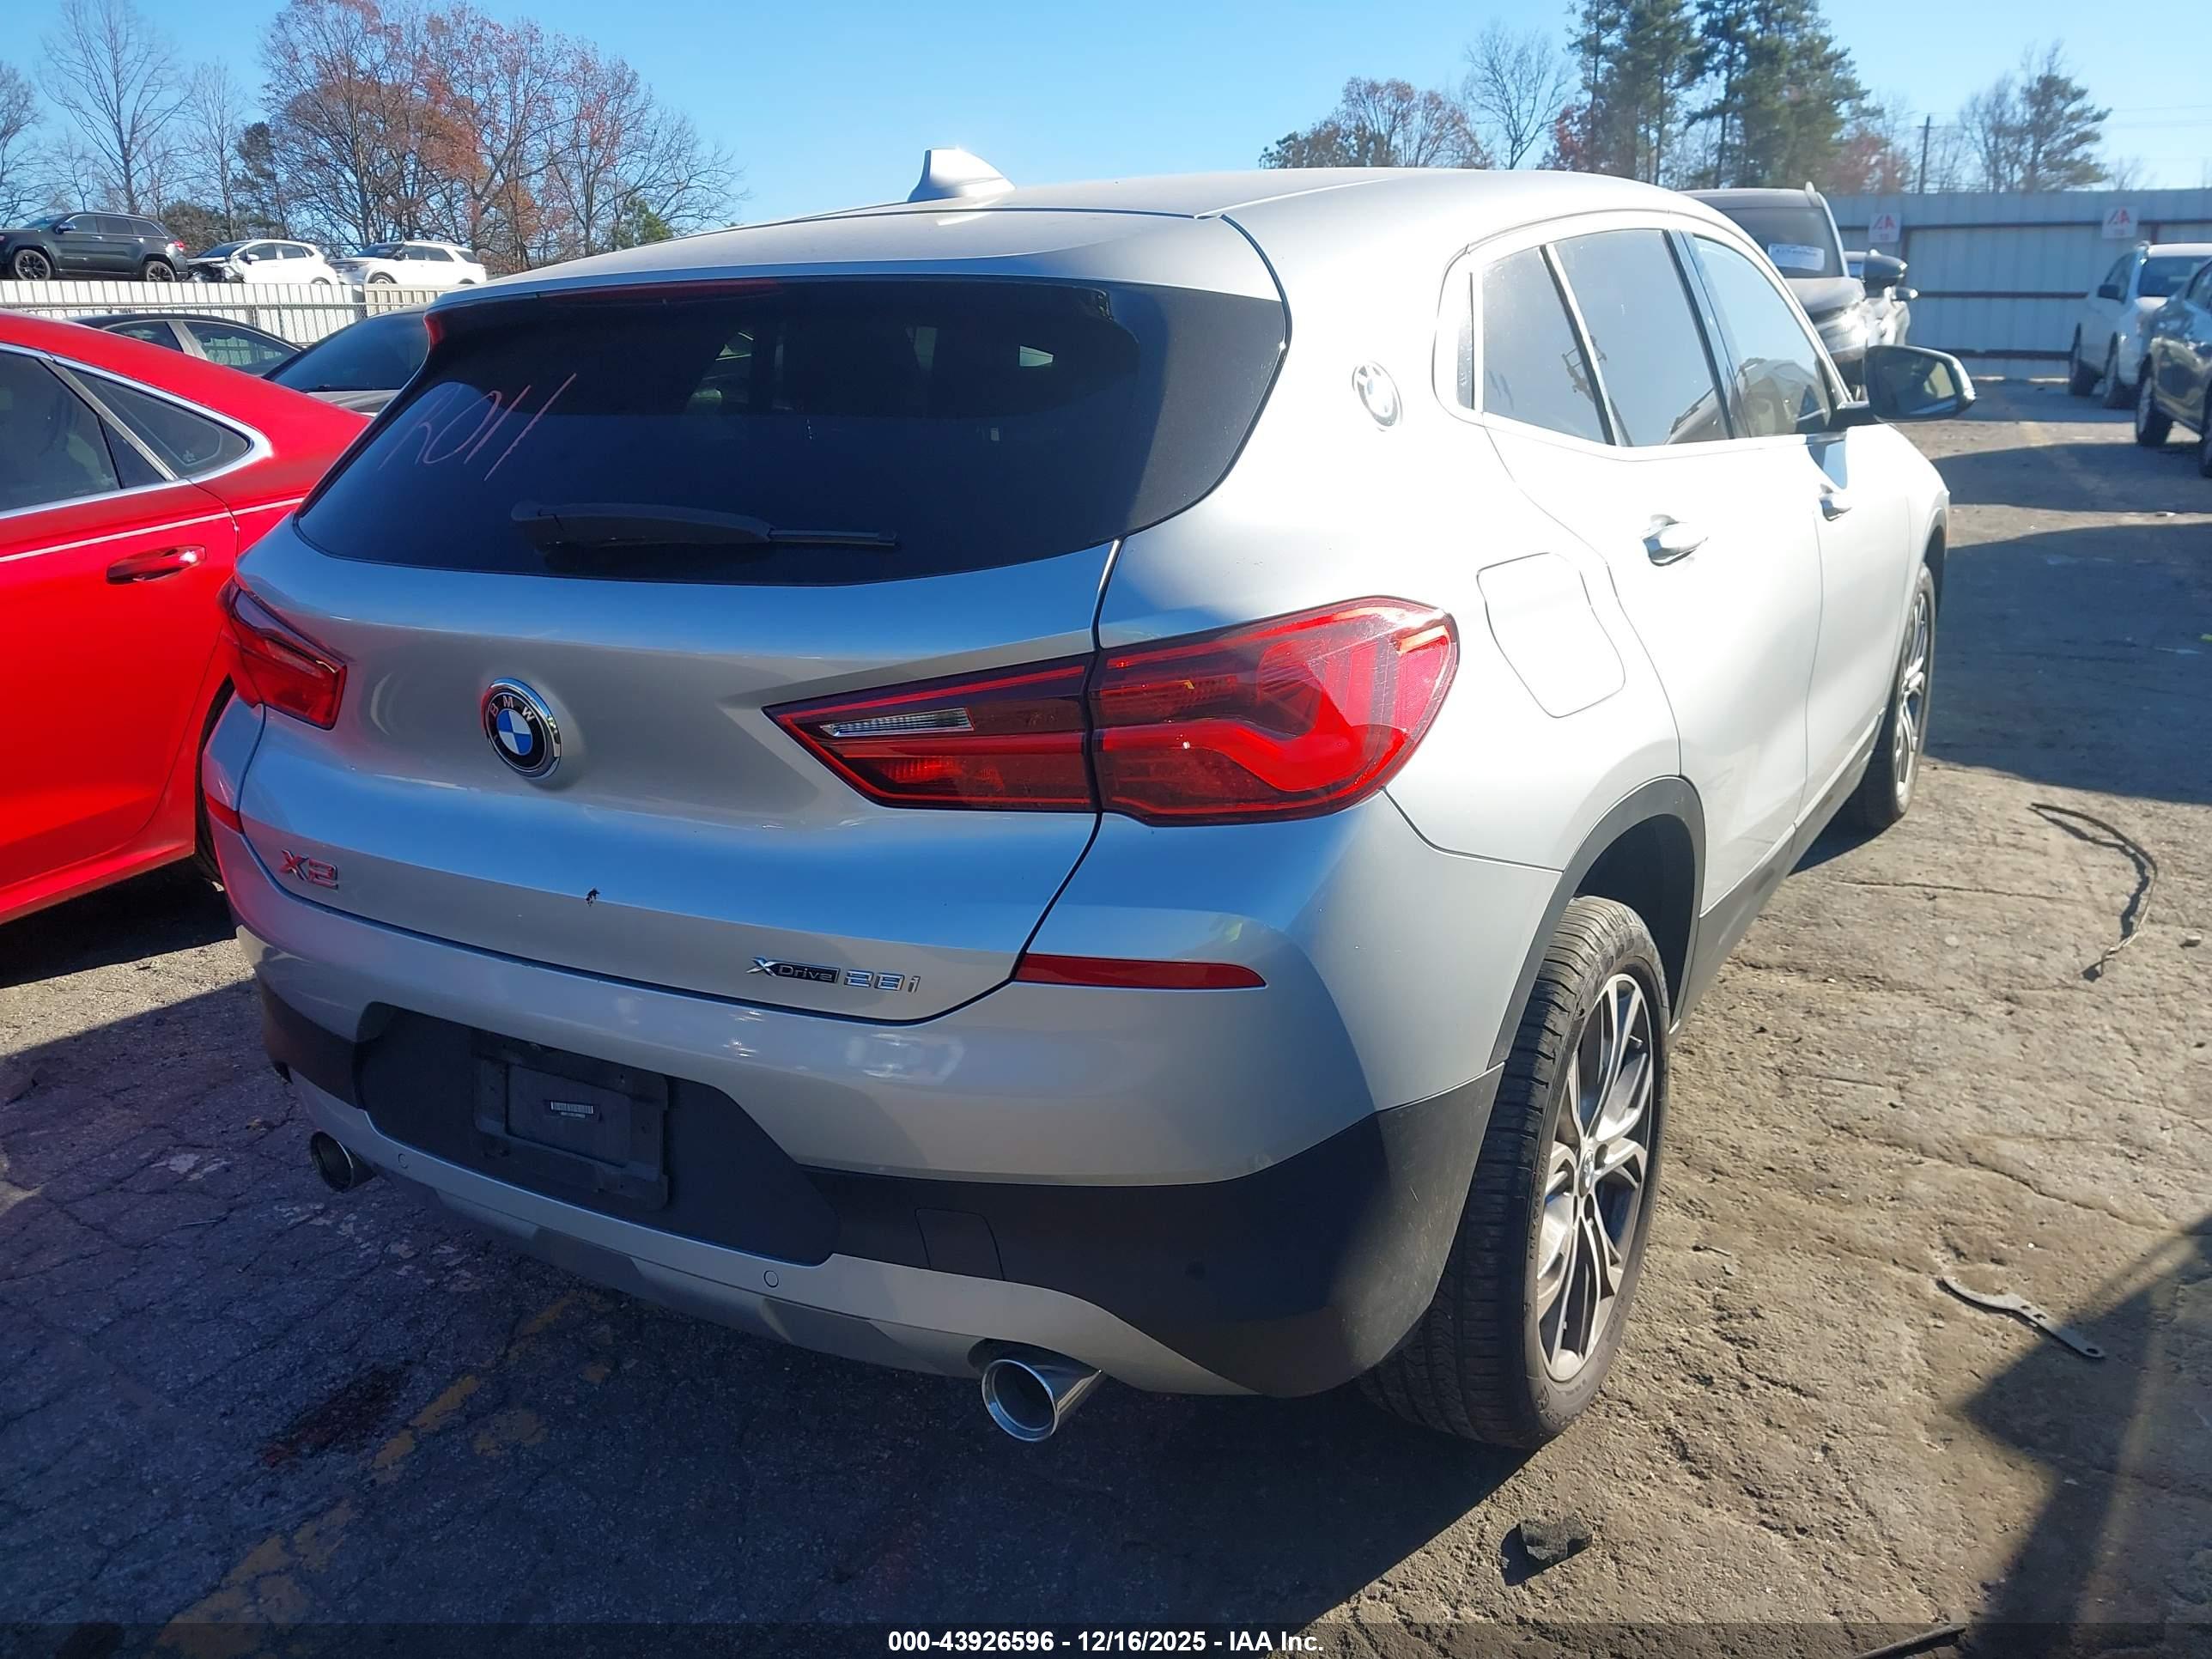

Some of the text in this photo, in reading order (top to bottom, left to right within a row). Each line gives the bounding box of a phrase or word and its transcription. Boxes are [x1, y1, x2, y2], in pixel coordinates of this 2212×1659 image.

[489, 695, 536, 722] BMW
[279, 848, 339, 890] X2
[843, 969, 921, 994] 28i
